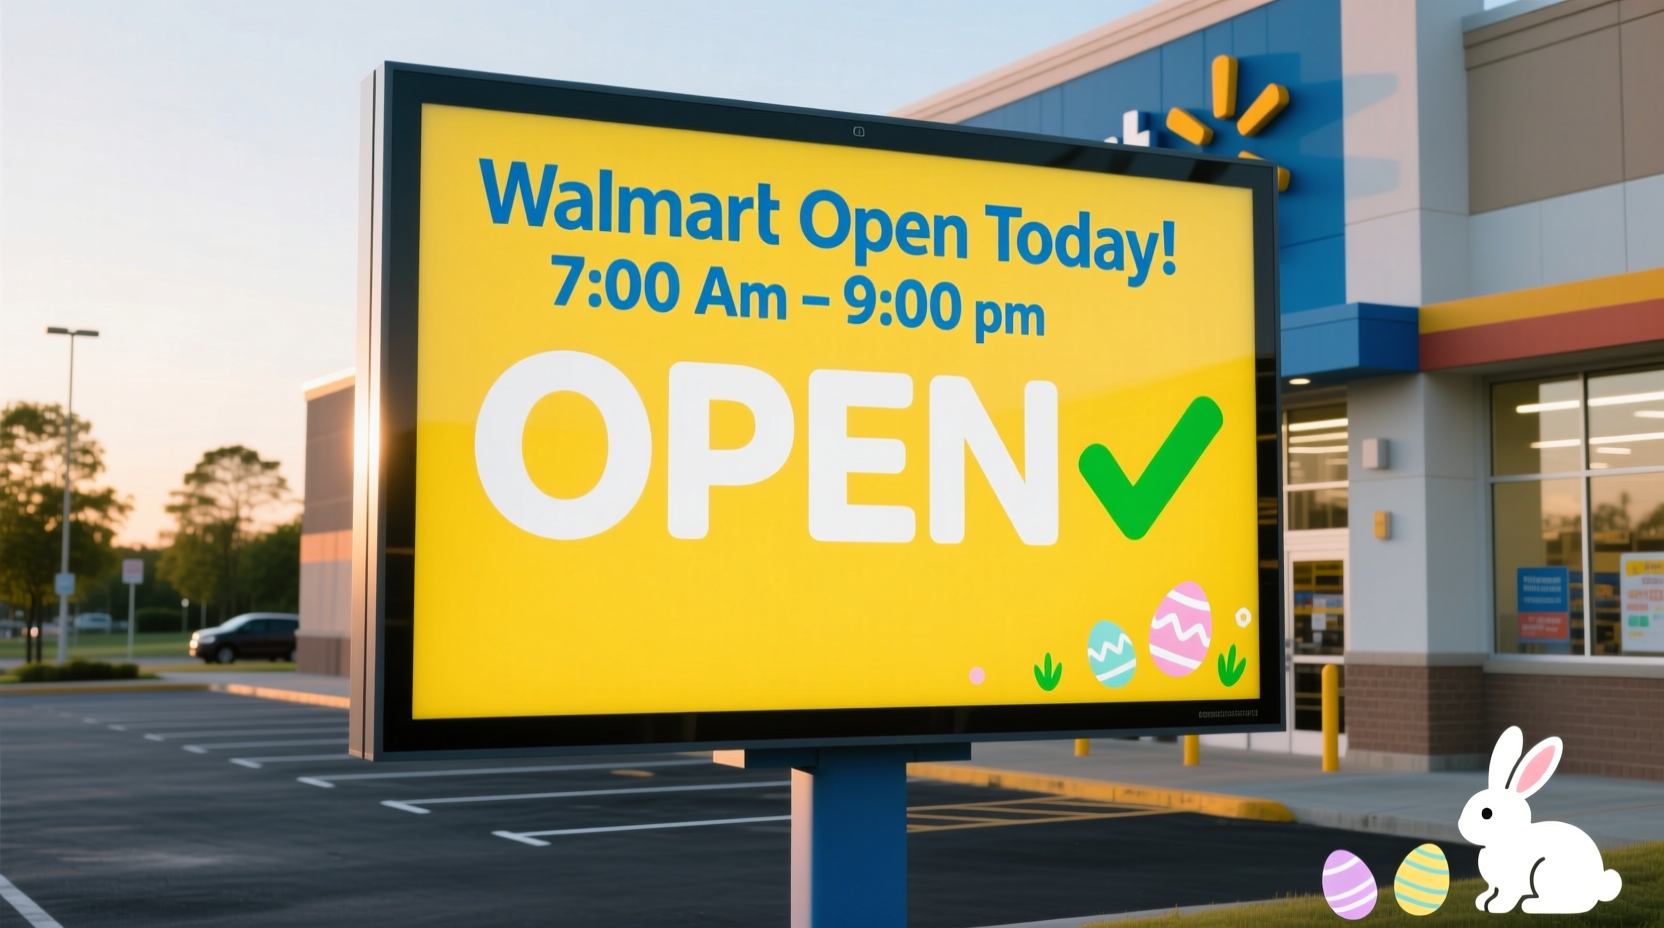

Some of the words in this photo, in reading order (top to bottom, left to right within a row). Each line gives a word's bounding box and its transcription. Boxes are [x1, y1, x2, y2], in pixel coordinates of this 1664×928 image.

[478, 158, 780, 246] Walmart
[799, 189, 968, 267] Open
[984, 204, 1177, 288] Today!
[551, 254, 680, 313] 7:00
[694, 266, 787, 321] Am
[843, 274, 962, 331] 9:00
[975, 300, 1045, 344] pm
[474, 349, 1060, 547] OPEN
